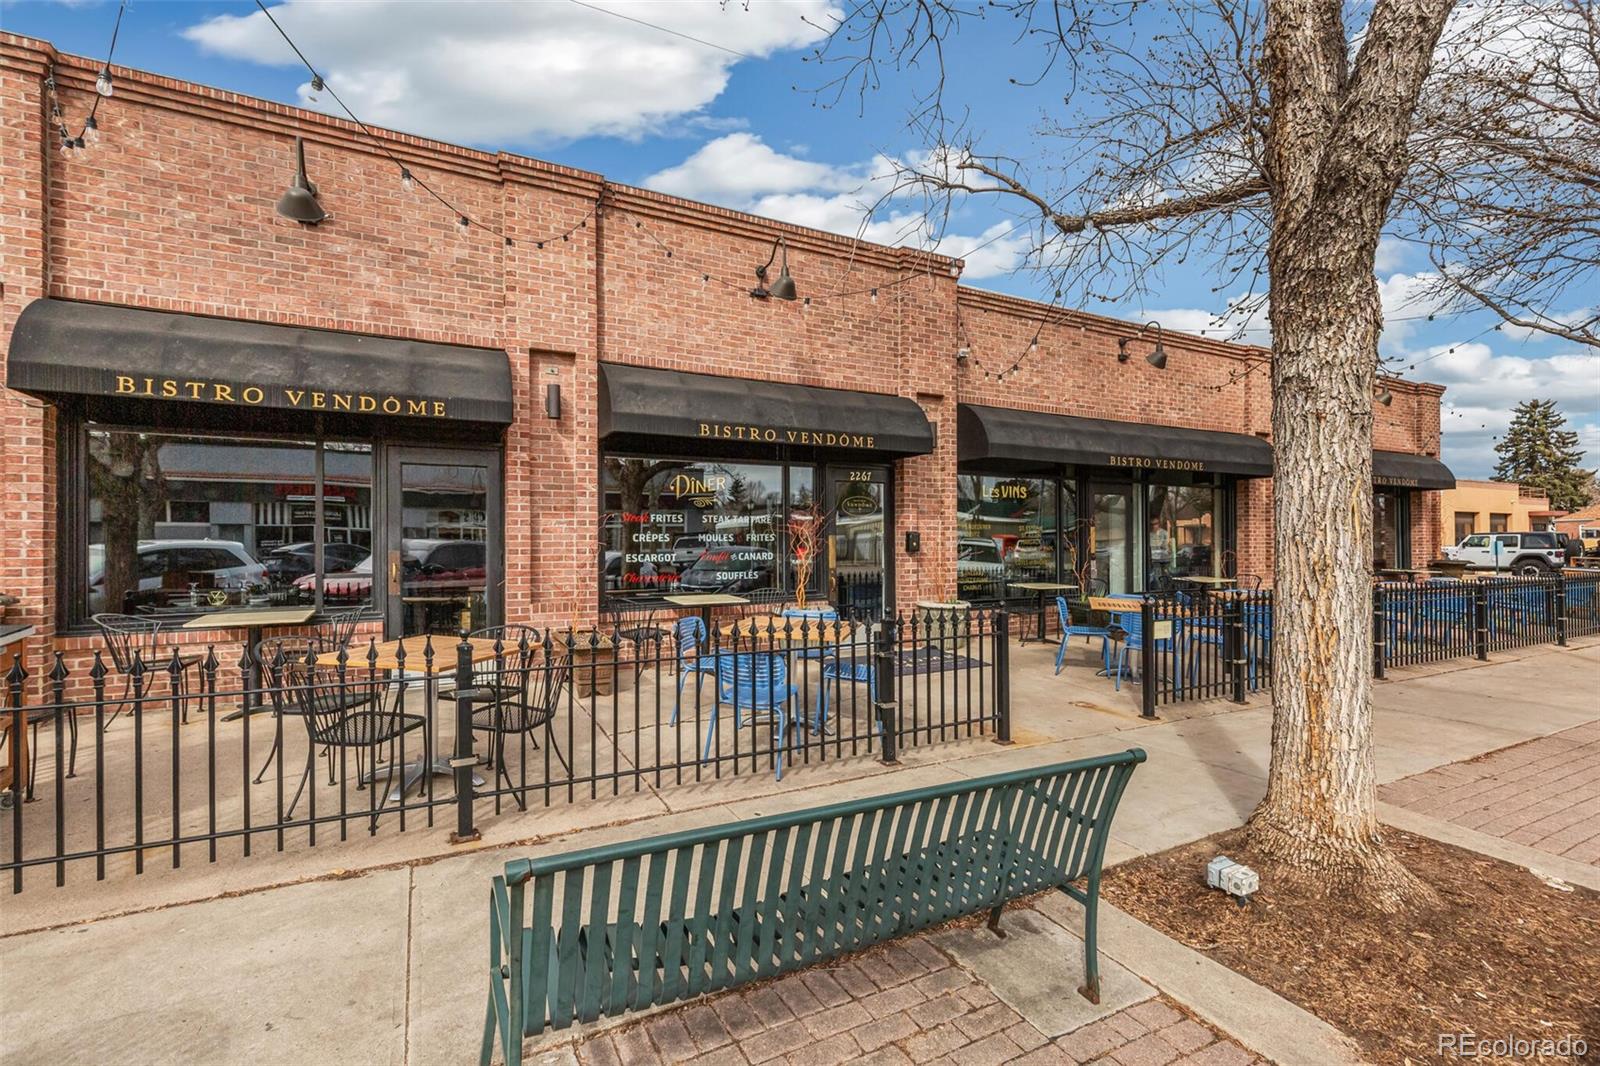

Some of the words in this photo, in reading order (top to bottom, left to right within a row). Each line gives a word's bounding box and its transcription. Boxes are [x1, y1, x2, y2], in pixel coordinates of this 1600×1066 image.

[115, 376, 264, 404] BISTRO
[286, 389, 446, 417] VENDÔME
[699, 424, 776, 442] BISTRO
[786, 431, 876, 449] VENDÔME
[1109, 456, 1151, 468] BISTRO
[850, 471, 872, 481] 2267
[670, 474, 726, 500] DÎNER
[1000, 485, 1028, 499] VINS
[650, 513, 684, 523] FRITES
[702, 515, 731, 523] STEAK
[632, 530, 670, 543] CRÊPES
[698, 533, 734, 542] MOULES
[746, 533, 775, 542] FRITES
[625, 553, 677, 563] ESCARGOT
[738, 552, 774, 561] CANARD
[716, 570, 759, 580] SOUFFLÉS
